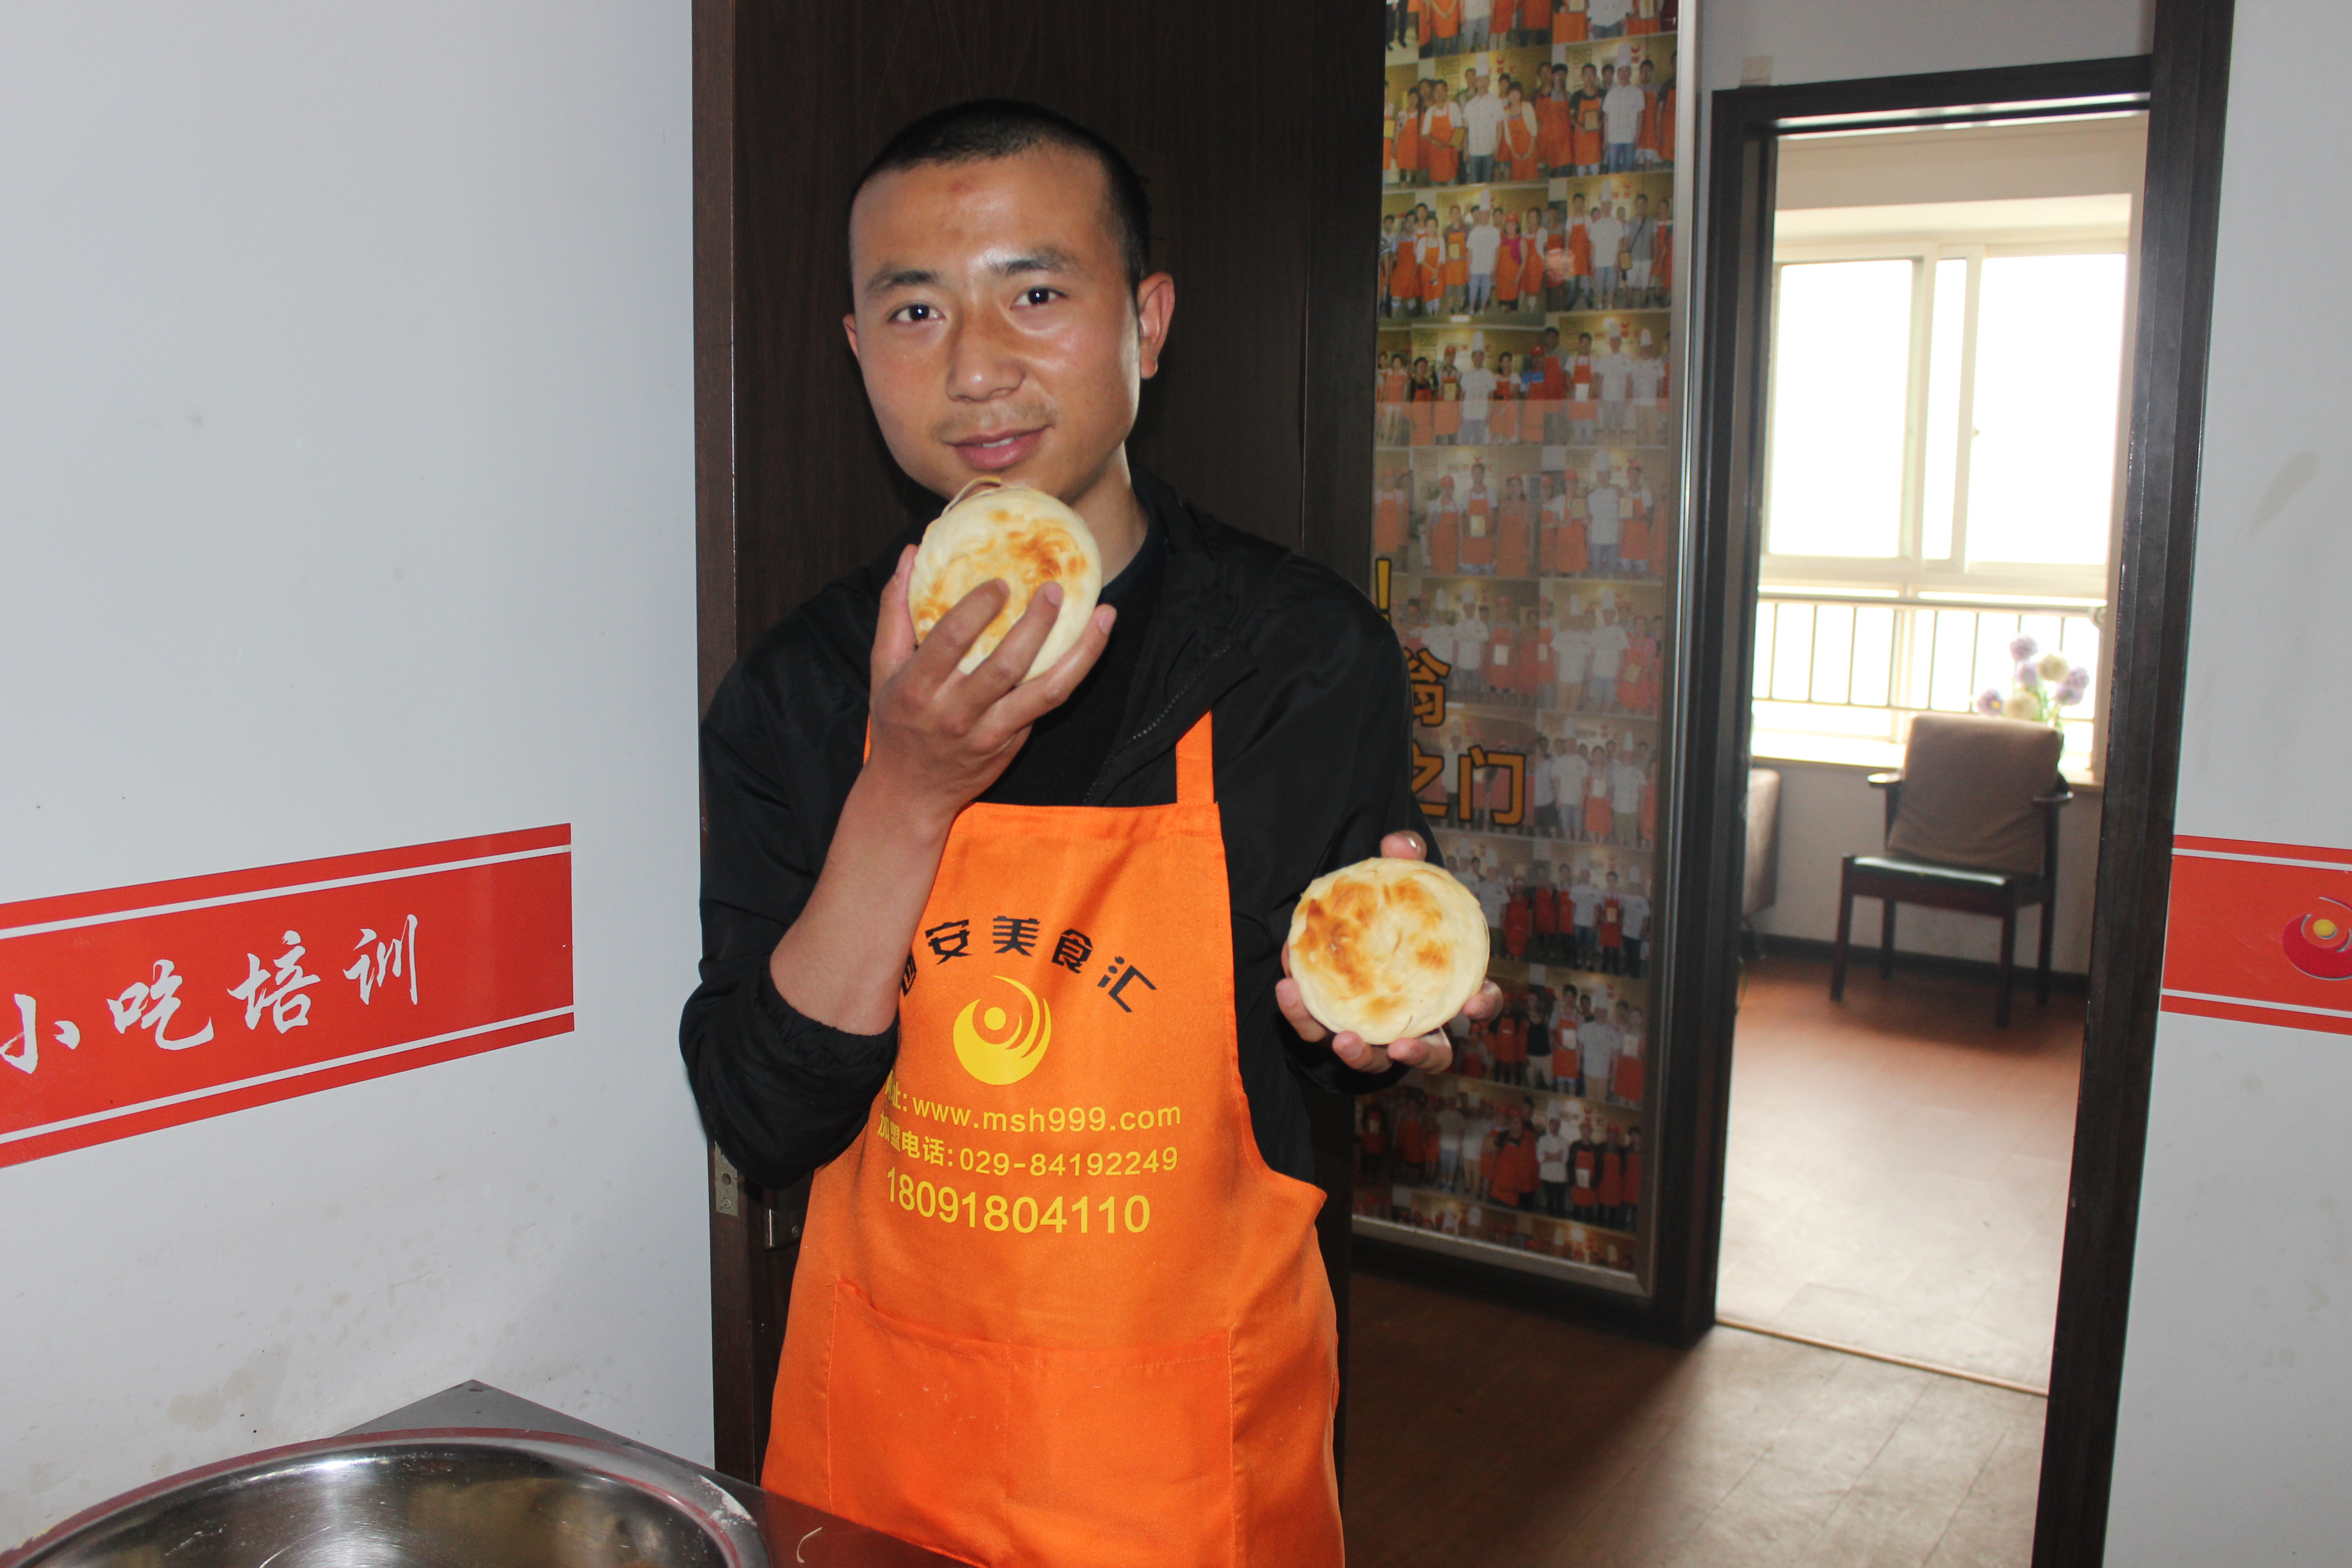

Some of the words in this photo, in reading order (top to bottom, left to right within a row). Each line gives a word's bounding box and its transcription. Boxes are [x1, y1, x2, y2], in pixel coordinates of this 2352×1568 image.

[0, 913, 418, 1074] 小吃培训
[887, 1166, 1151, 1234] 18091804110
